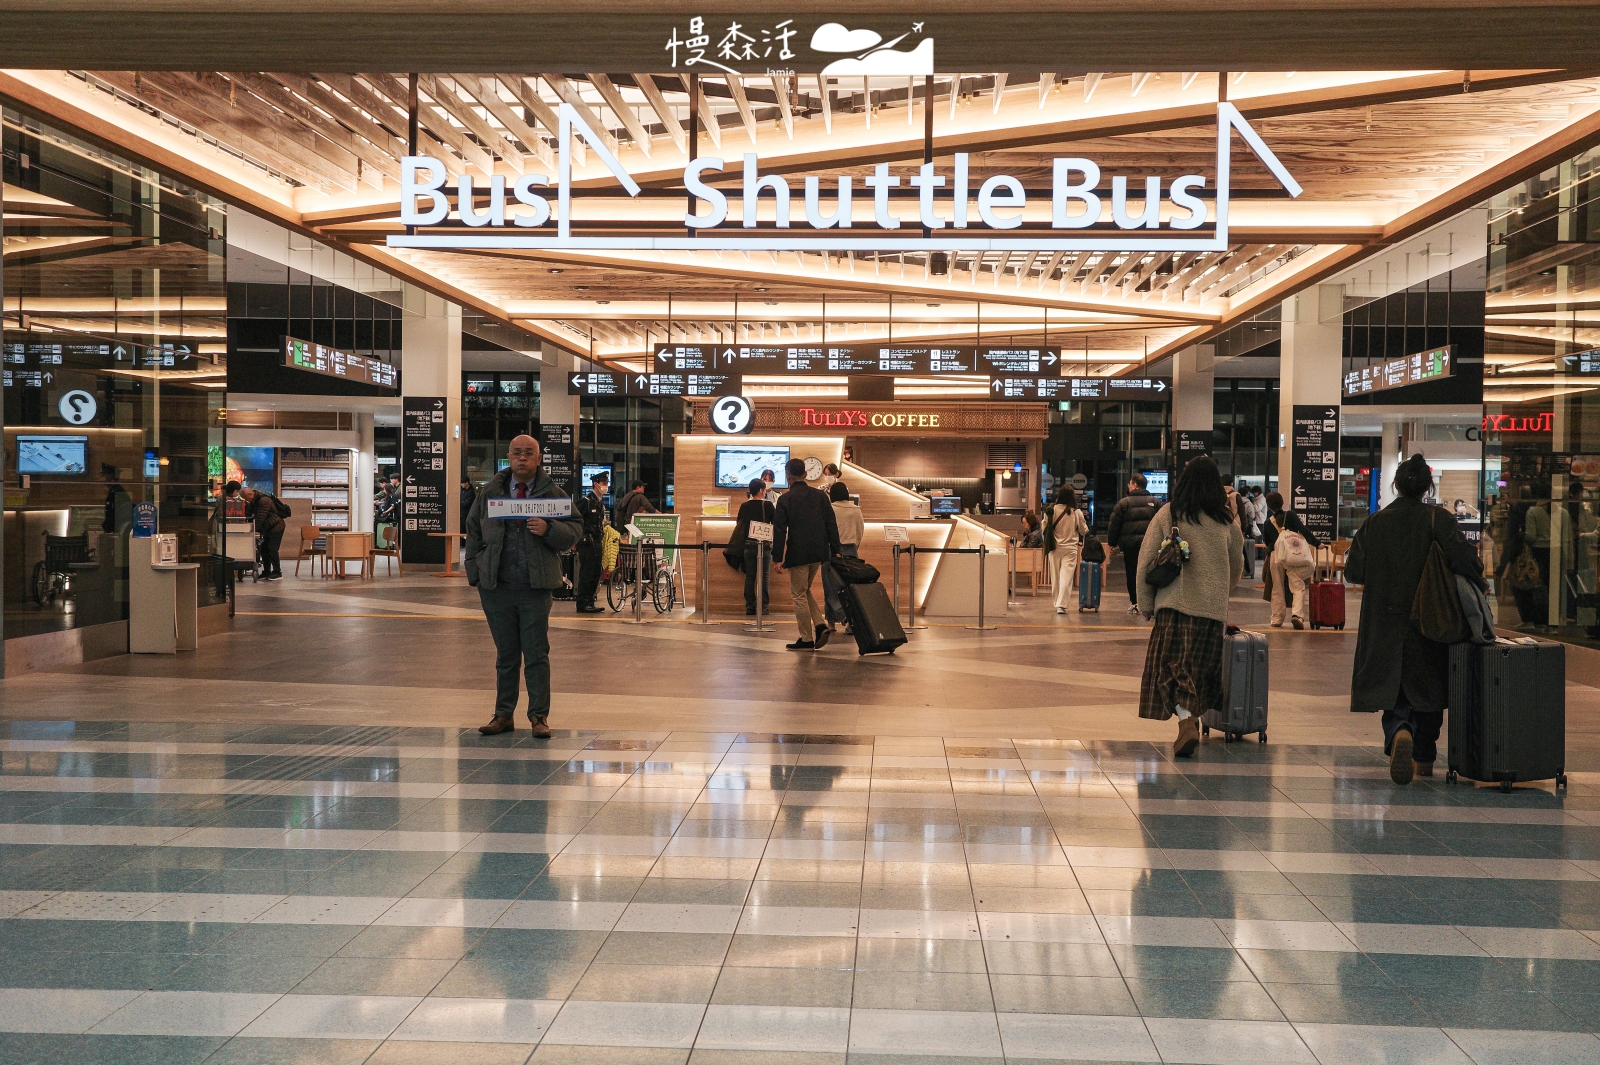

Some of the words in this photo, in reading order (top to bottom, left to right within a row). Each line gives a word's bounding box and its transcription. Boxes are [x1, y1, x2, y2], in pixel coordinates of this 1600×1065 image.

[401, 156, 551, 228] Bus
[683, 153, 1026, 230] Shuttle
[1052, 158, 1208, 230] Bus
[800, 408, 868, 426] TULLY'S
[871, 414, 940, 427] COFFEE
